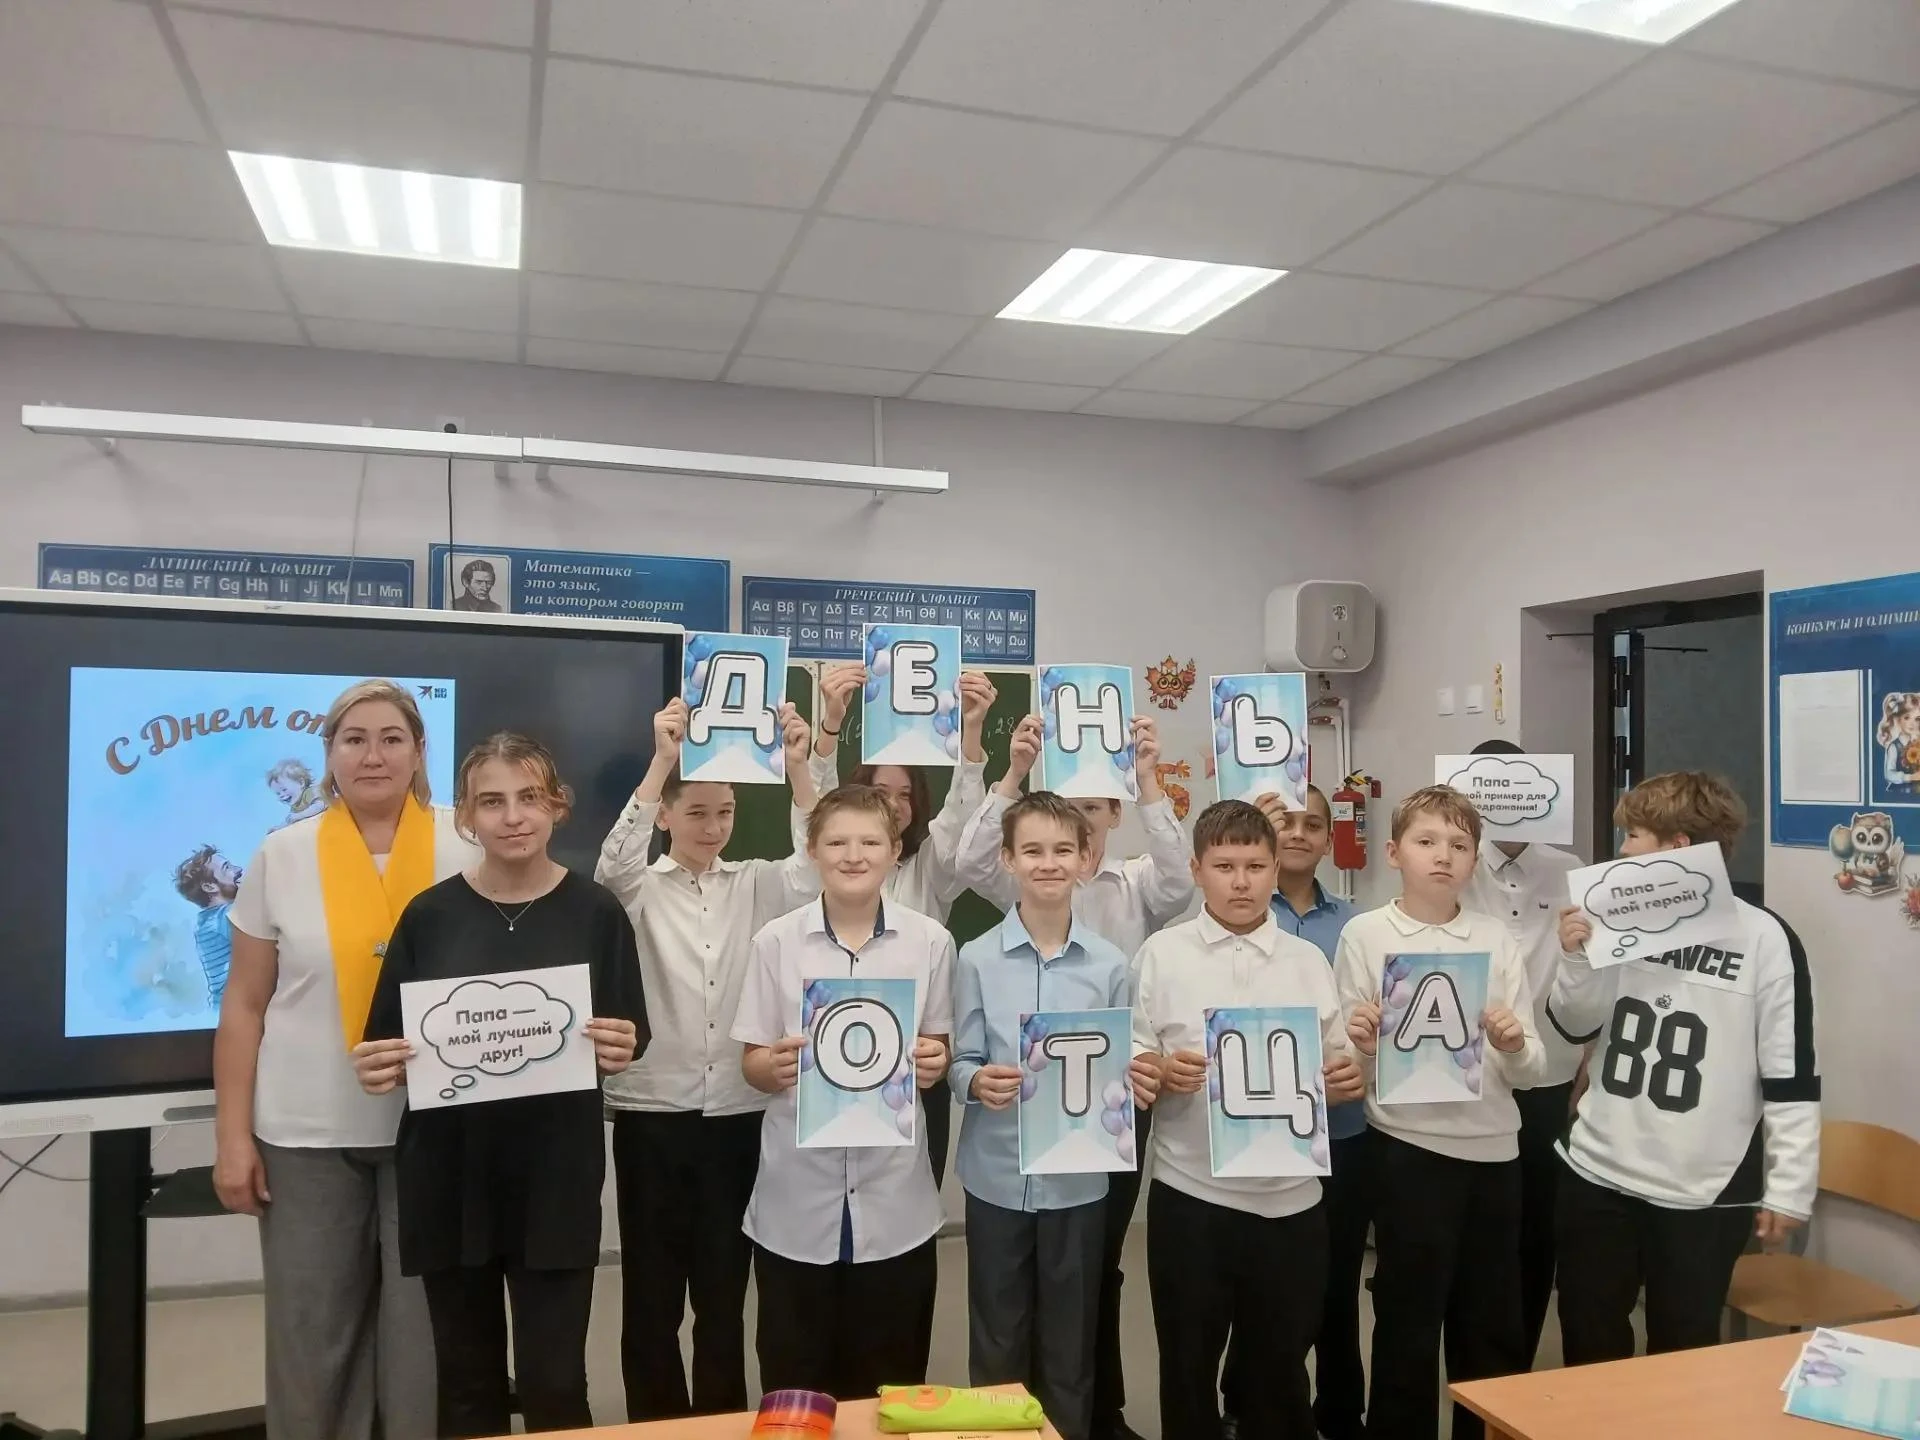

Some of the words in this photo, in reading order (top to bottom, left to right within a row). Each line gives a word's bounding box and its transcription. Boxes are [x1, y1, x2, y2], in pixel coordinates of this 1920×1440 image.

[142, 557, 252, 573] ЛАТИНСКИЙ
[256, 562, 336, 577] АЛФАВИТ
[524, 559, 632, 578] Математика
[49, 570, 73, 584] Aa
[77, 571, 100, 585] Bb
[106, 572, 129, 586] Cc
[134, 573, 158, 588] Dd
[163, 574, 185, 588] Ee
[193, 575, 211, 590] Ff
[219, 578, 240, 594] Gg
[246, 578, 269, 592] Hh
[303, 581, 318, 597] Jj
[380, 585, 403, 598] Mm
[524, 579, 556, 590] это
[558, 580, 601, 593] язык,
[524, 594, 543, 605] на
[547, 595, 617, 611] котором
[621, 600, 685, 614] говорят
[835, 588, 916, 603] ГРЕЧЕСКИЙ
[919, 592, 981, 607] АЛФАВИТ
[825, 604, 842, 615] Δδ
[1786, 618, 1852, 636] КОНКУРСЫ
[891, 640, 939, 715] Е
[687, 650, 778, 746] Д
[1055, 682, 1125, 754] Н
[105, 737, 141, 775] С
[140, 706, 278, 756] Днем
[1472, 776, 1510, 788] Папа
[1484, 792, 1524, 801] пример
[1526, 793, 1547, 801] для
[1473, 804, 1538, 812] одражания!
[1610, 881, 1655, 900] Папа
[1607, 901, 1641, 917] мой
[1644, 890, 1697, 911] герой!
[455, 1007, 508, 1025] Папа
[1394, 971, 1469, 1052] А
[447, 1029, 482, 1047] мой
[486, 1020, 552, 1044] лучший
[479, 1044, 524, 1064] друг!
[813, 997, 904, 1092] О
[1602, 996, 1708, 1113] 88
[1042, 1031, 1111, 1118] Т
[1216, 1028, 1318, 1139] Ц
